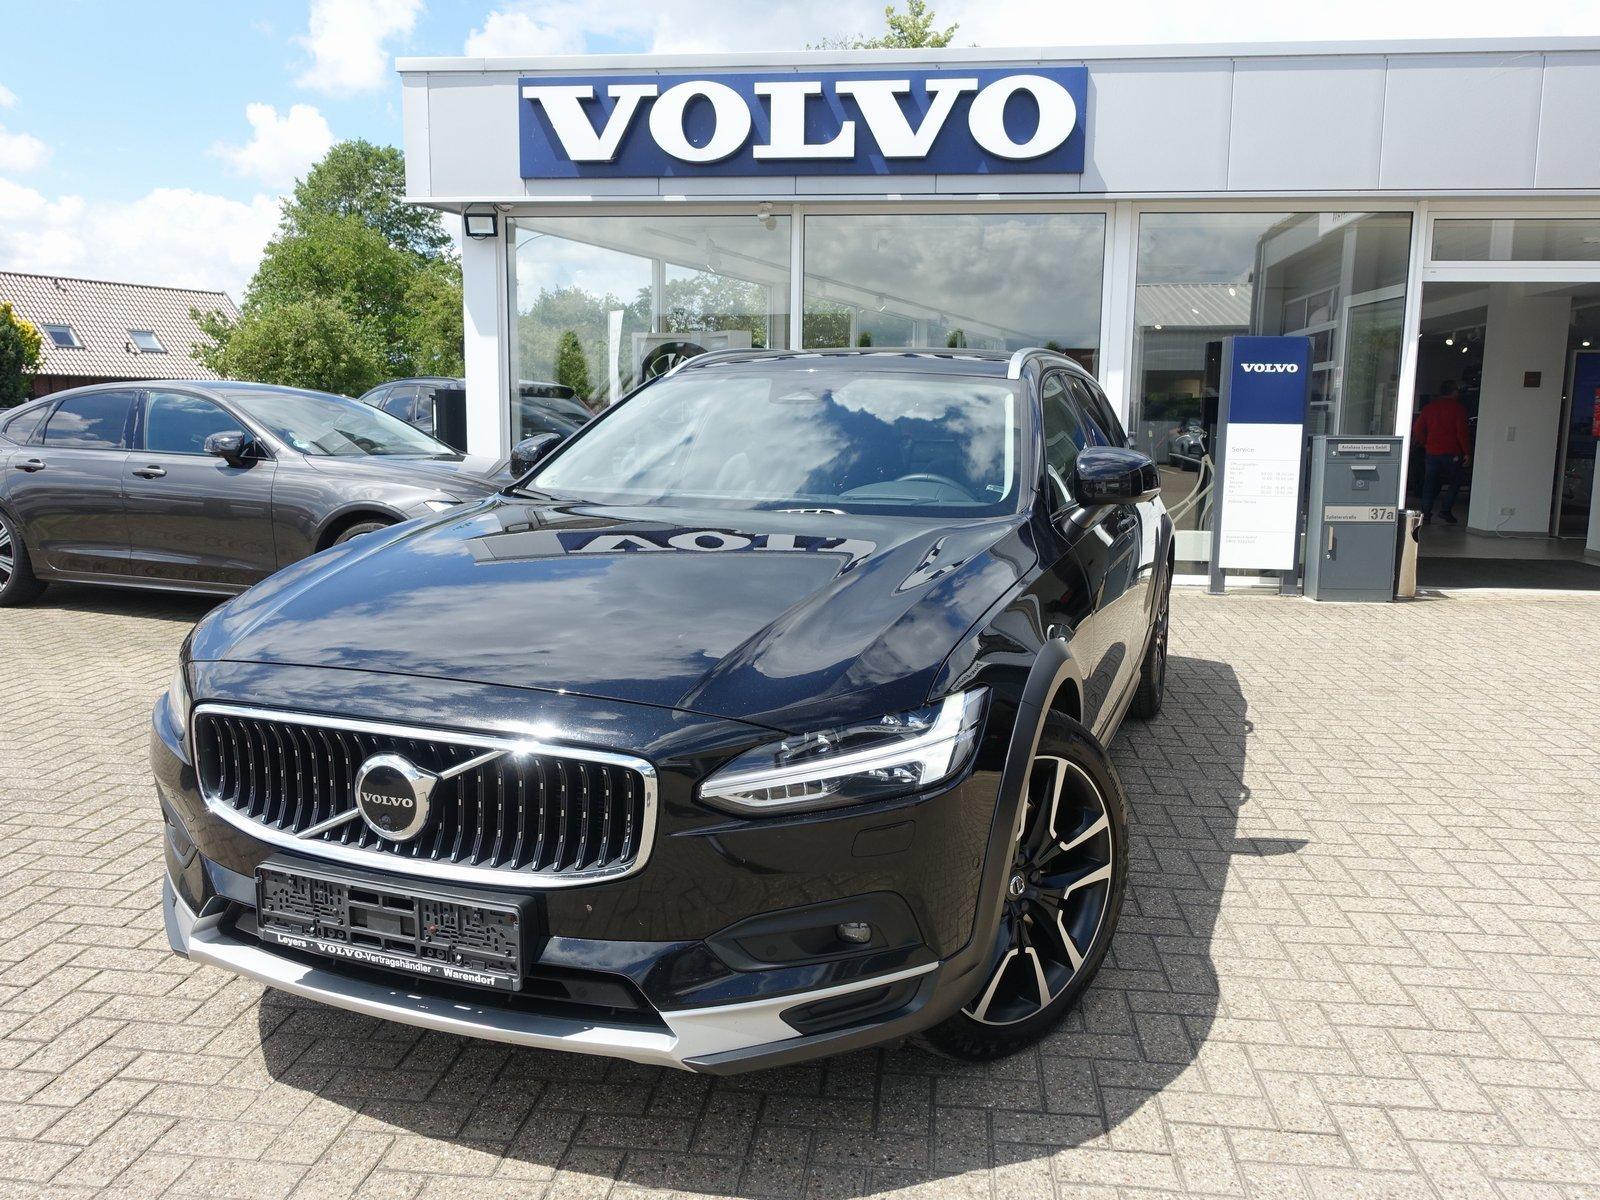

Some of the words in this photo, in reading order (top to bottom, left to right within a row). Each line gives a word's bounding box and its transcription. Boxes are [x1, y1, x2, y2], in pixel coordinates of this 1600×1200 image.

[522, 74, 1077, 163] VOLVO
[1240, 363, 1299, 373] VOLVO
[1370, 508, 1394, 520] 37a
[361, 791, 414, 808] VOLVO
[277, 934, 307, 949] Leyers
[317, 942, 432, 974] VOLVO-Vertragshändler
[443, 967, 496, 987] Warendorf
